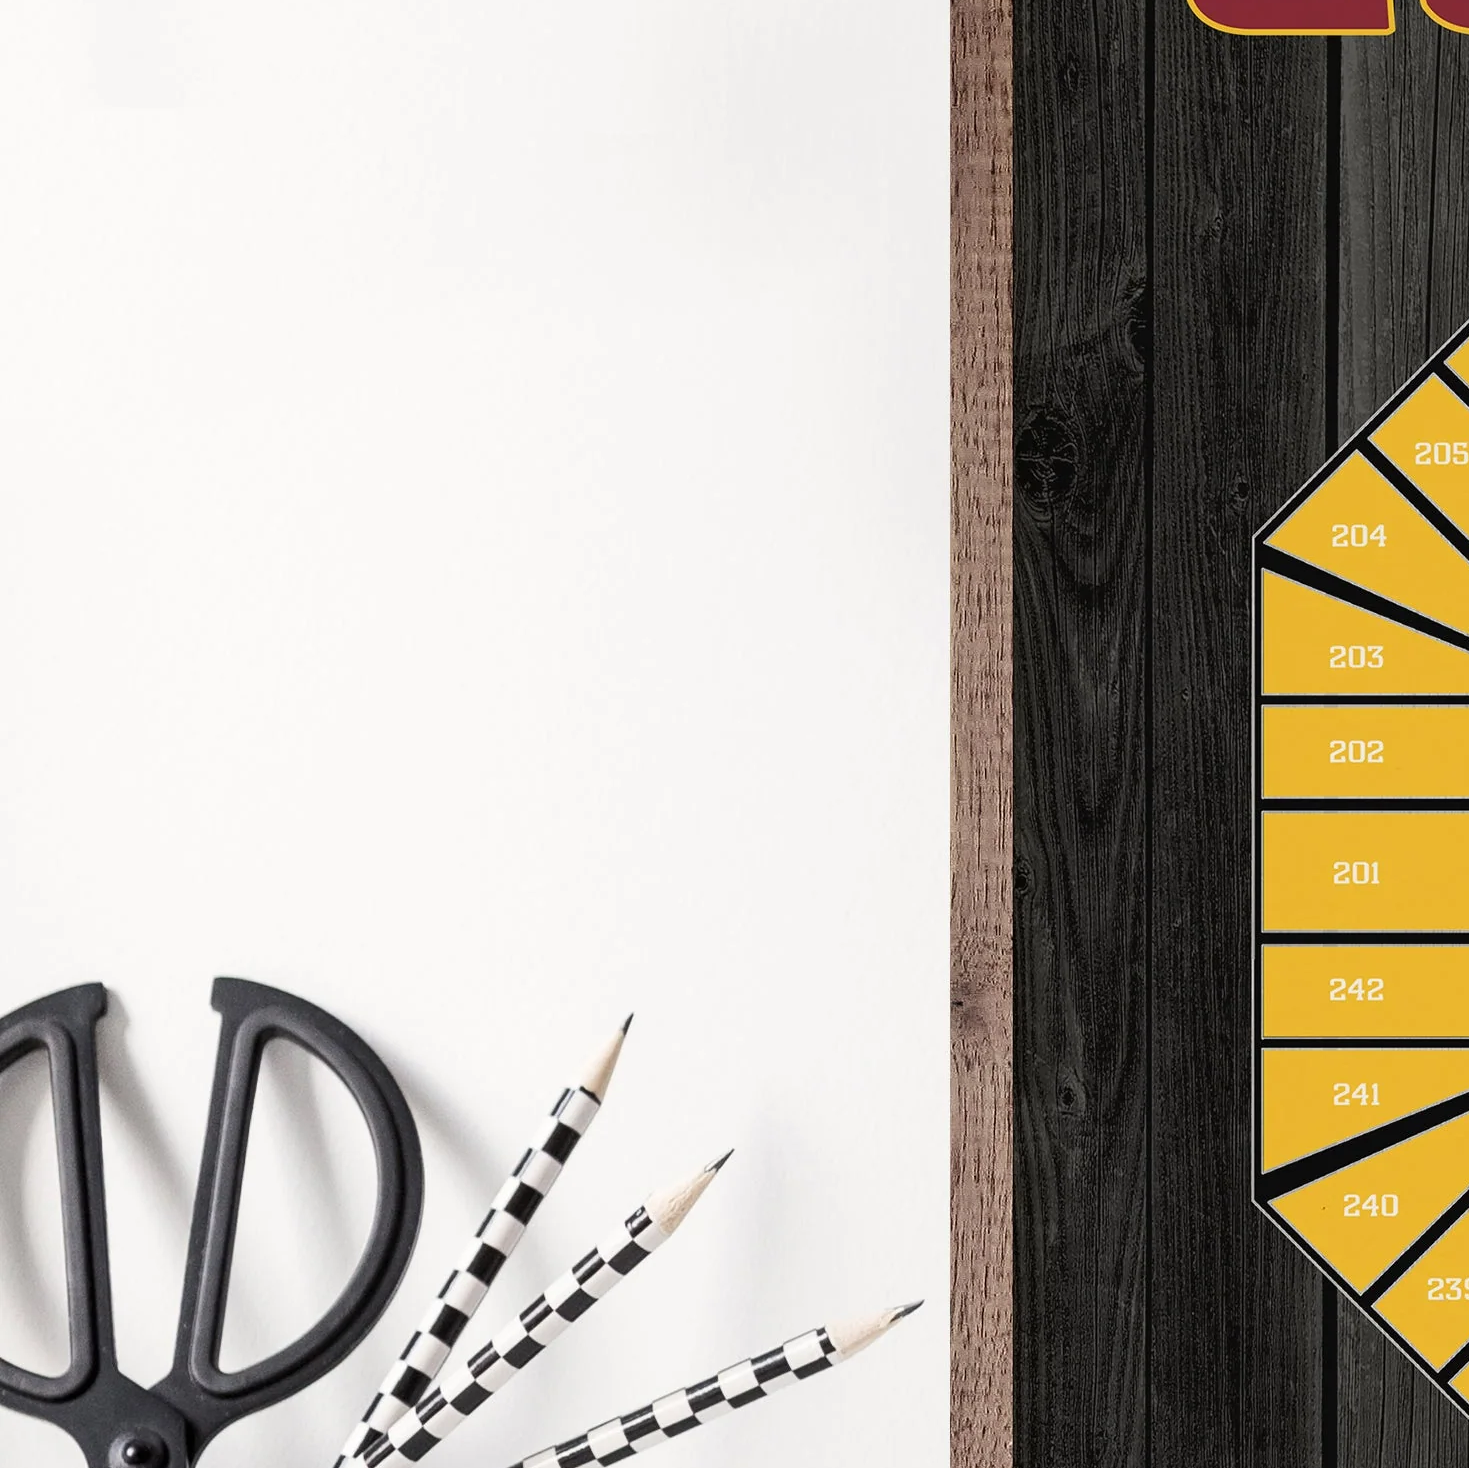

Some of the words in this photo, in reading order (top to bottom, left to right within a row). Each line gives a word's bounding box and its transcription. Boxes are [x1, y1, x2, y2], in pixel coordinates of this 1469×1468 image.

[1414, 442, 1469, 465] 205
[1331, 524, 1387, 548] 204
[1329, 645, 1384, 669] 203
[1329, 740, 1384, 764] 202
[1333, 861, 1380, 885] 201
[1329, 978, 1384, 1001] 242
[1333, 1082, 1380, 1106] 241
[1343, 1194, 1399, 1217] 240
